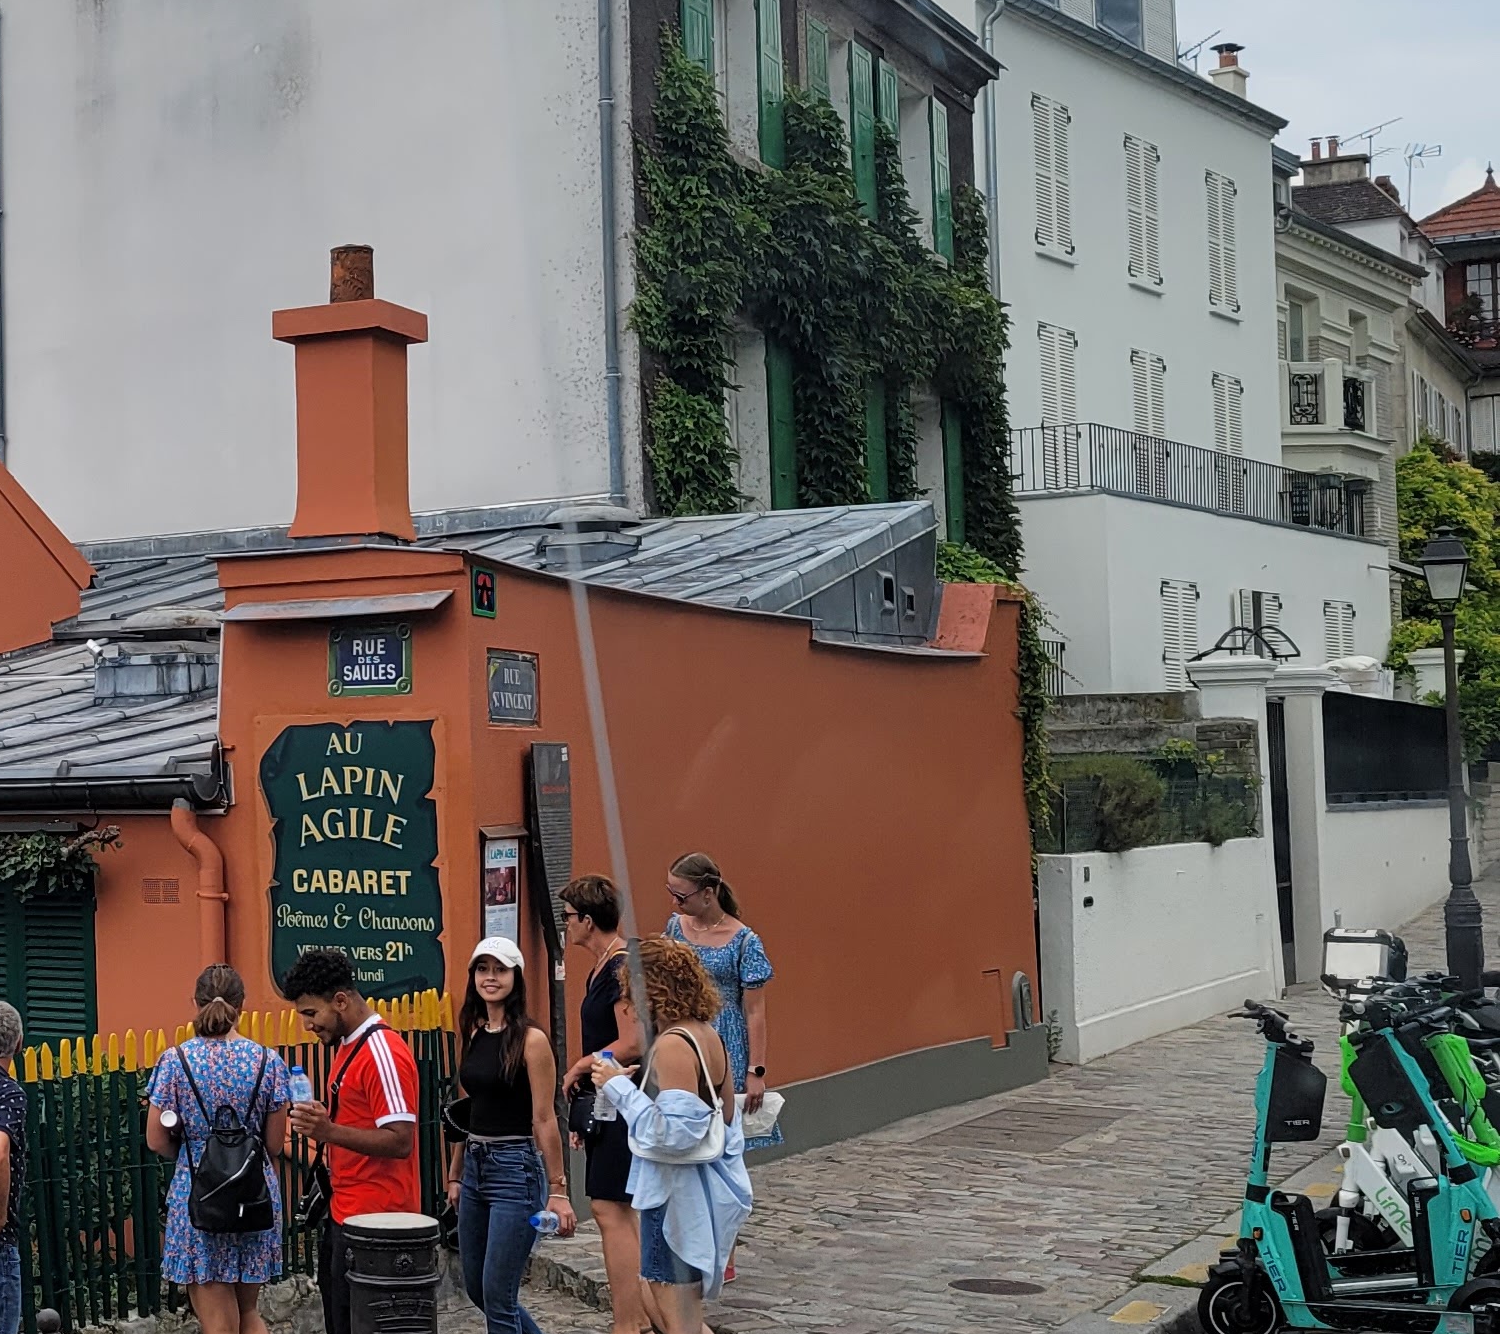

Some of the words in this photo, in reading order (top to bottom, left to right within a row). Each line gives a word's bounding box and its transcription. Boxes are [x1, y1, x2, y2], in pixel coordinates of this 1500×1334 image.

[352, 638, 386, 656] RUE
[357, 655, 381, 664] DES
[343, 663, 397, 681] SAULES
[503, 667, 521, 685] RUE
[325, 732, 363, 756] AU
[295, 766, 404, 805] LAPIN
[300, 807, 408, 850] AGILE
[292, 868, 412, 896] CABARET
[333, 902, 354, 929] &
[358, 906, 436, 932] Chansons
[351, 946, 384, 961] VERS
[357, 968, 385, 982] lundi
[1414, 1196, 1423, 1218] TIER
[1290, 1209, 1300, 1232] TIER
[1452, 1229, 1470, 1276] TIER
[1262, 1244, 1287, 1294] TIER
